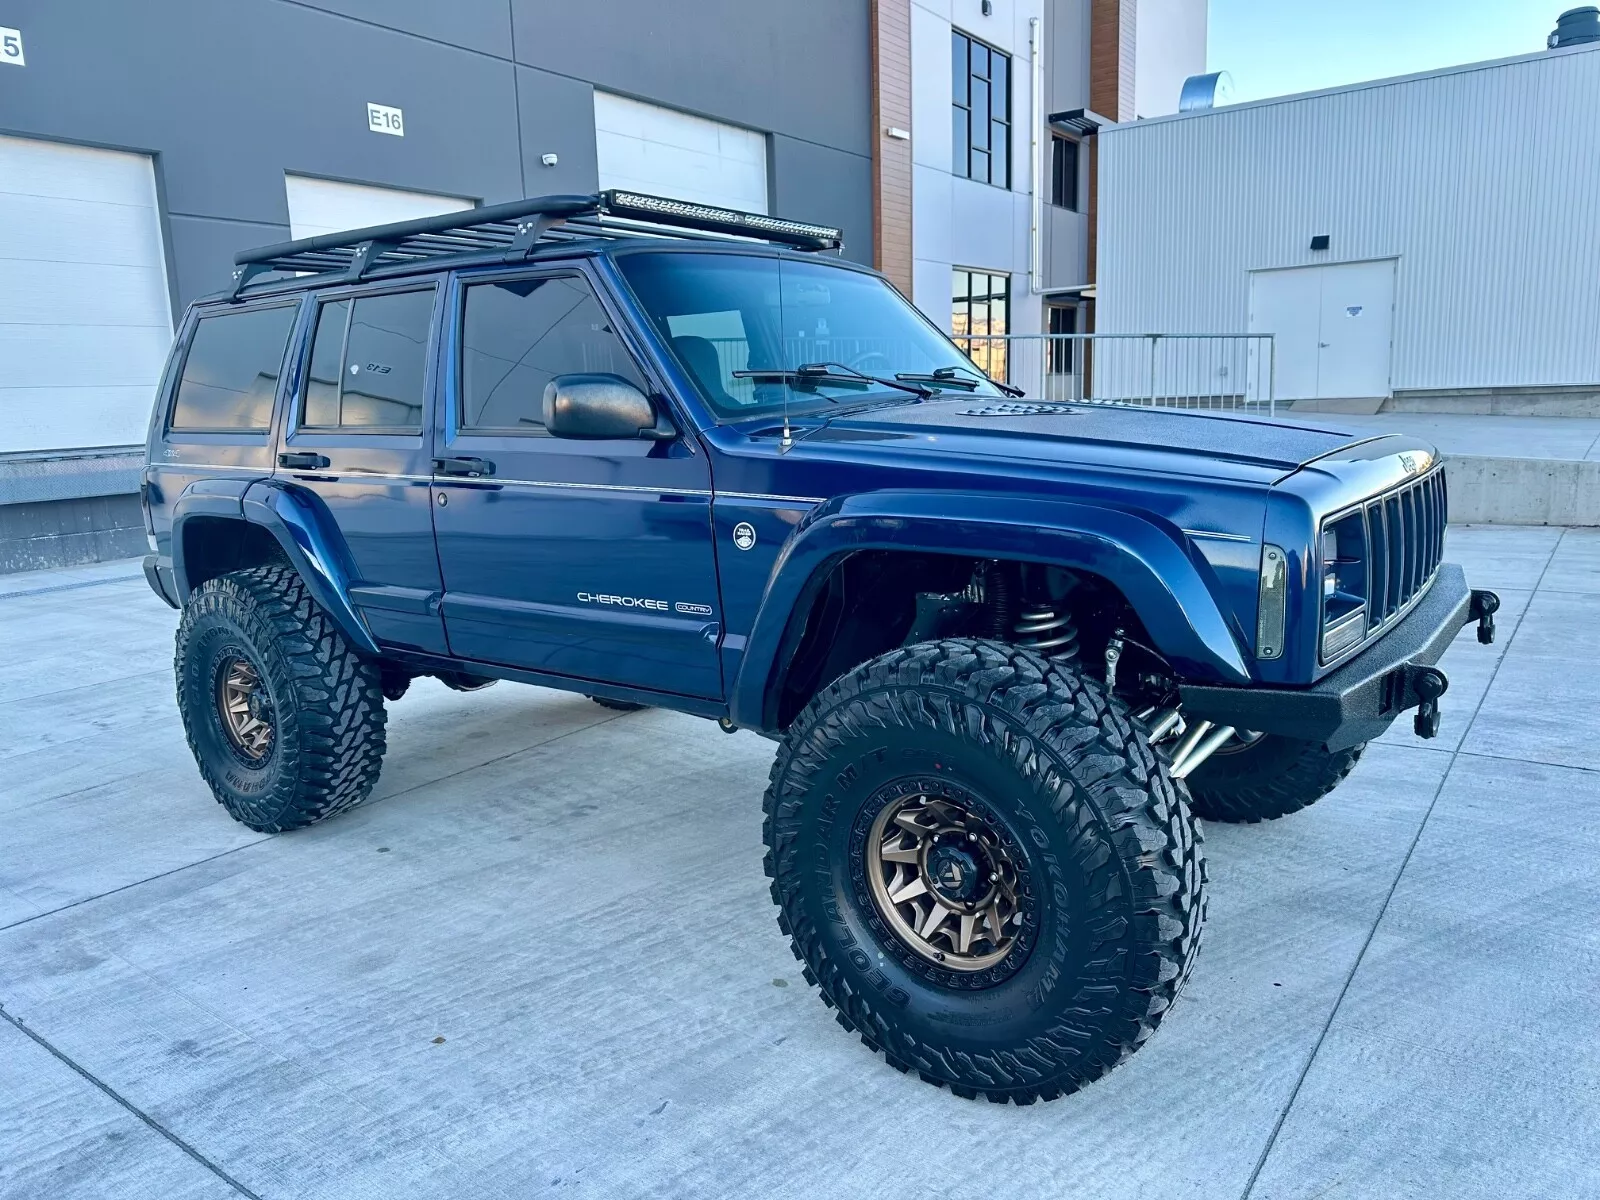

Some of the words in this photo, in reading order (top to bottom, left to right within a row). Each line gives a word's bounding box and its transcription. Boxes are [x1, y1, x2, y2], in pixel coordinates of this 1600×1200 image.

[0, 35, 20, 57] 5
[370, 109, 401, 130] E16
[577, 592, 669, 611] CHEROKEE
[677, 603, 710, 614] COUNTRY
[814, 793, 912, 1009] GEOLANDAR
[1014, 798, 1071, 1011] YOKOHAMA
